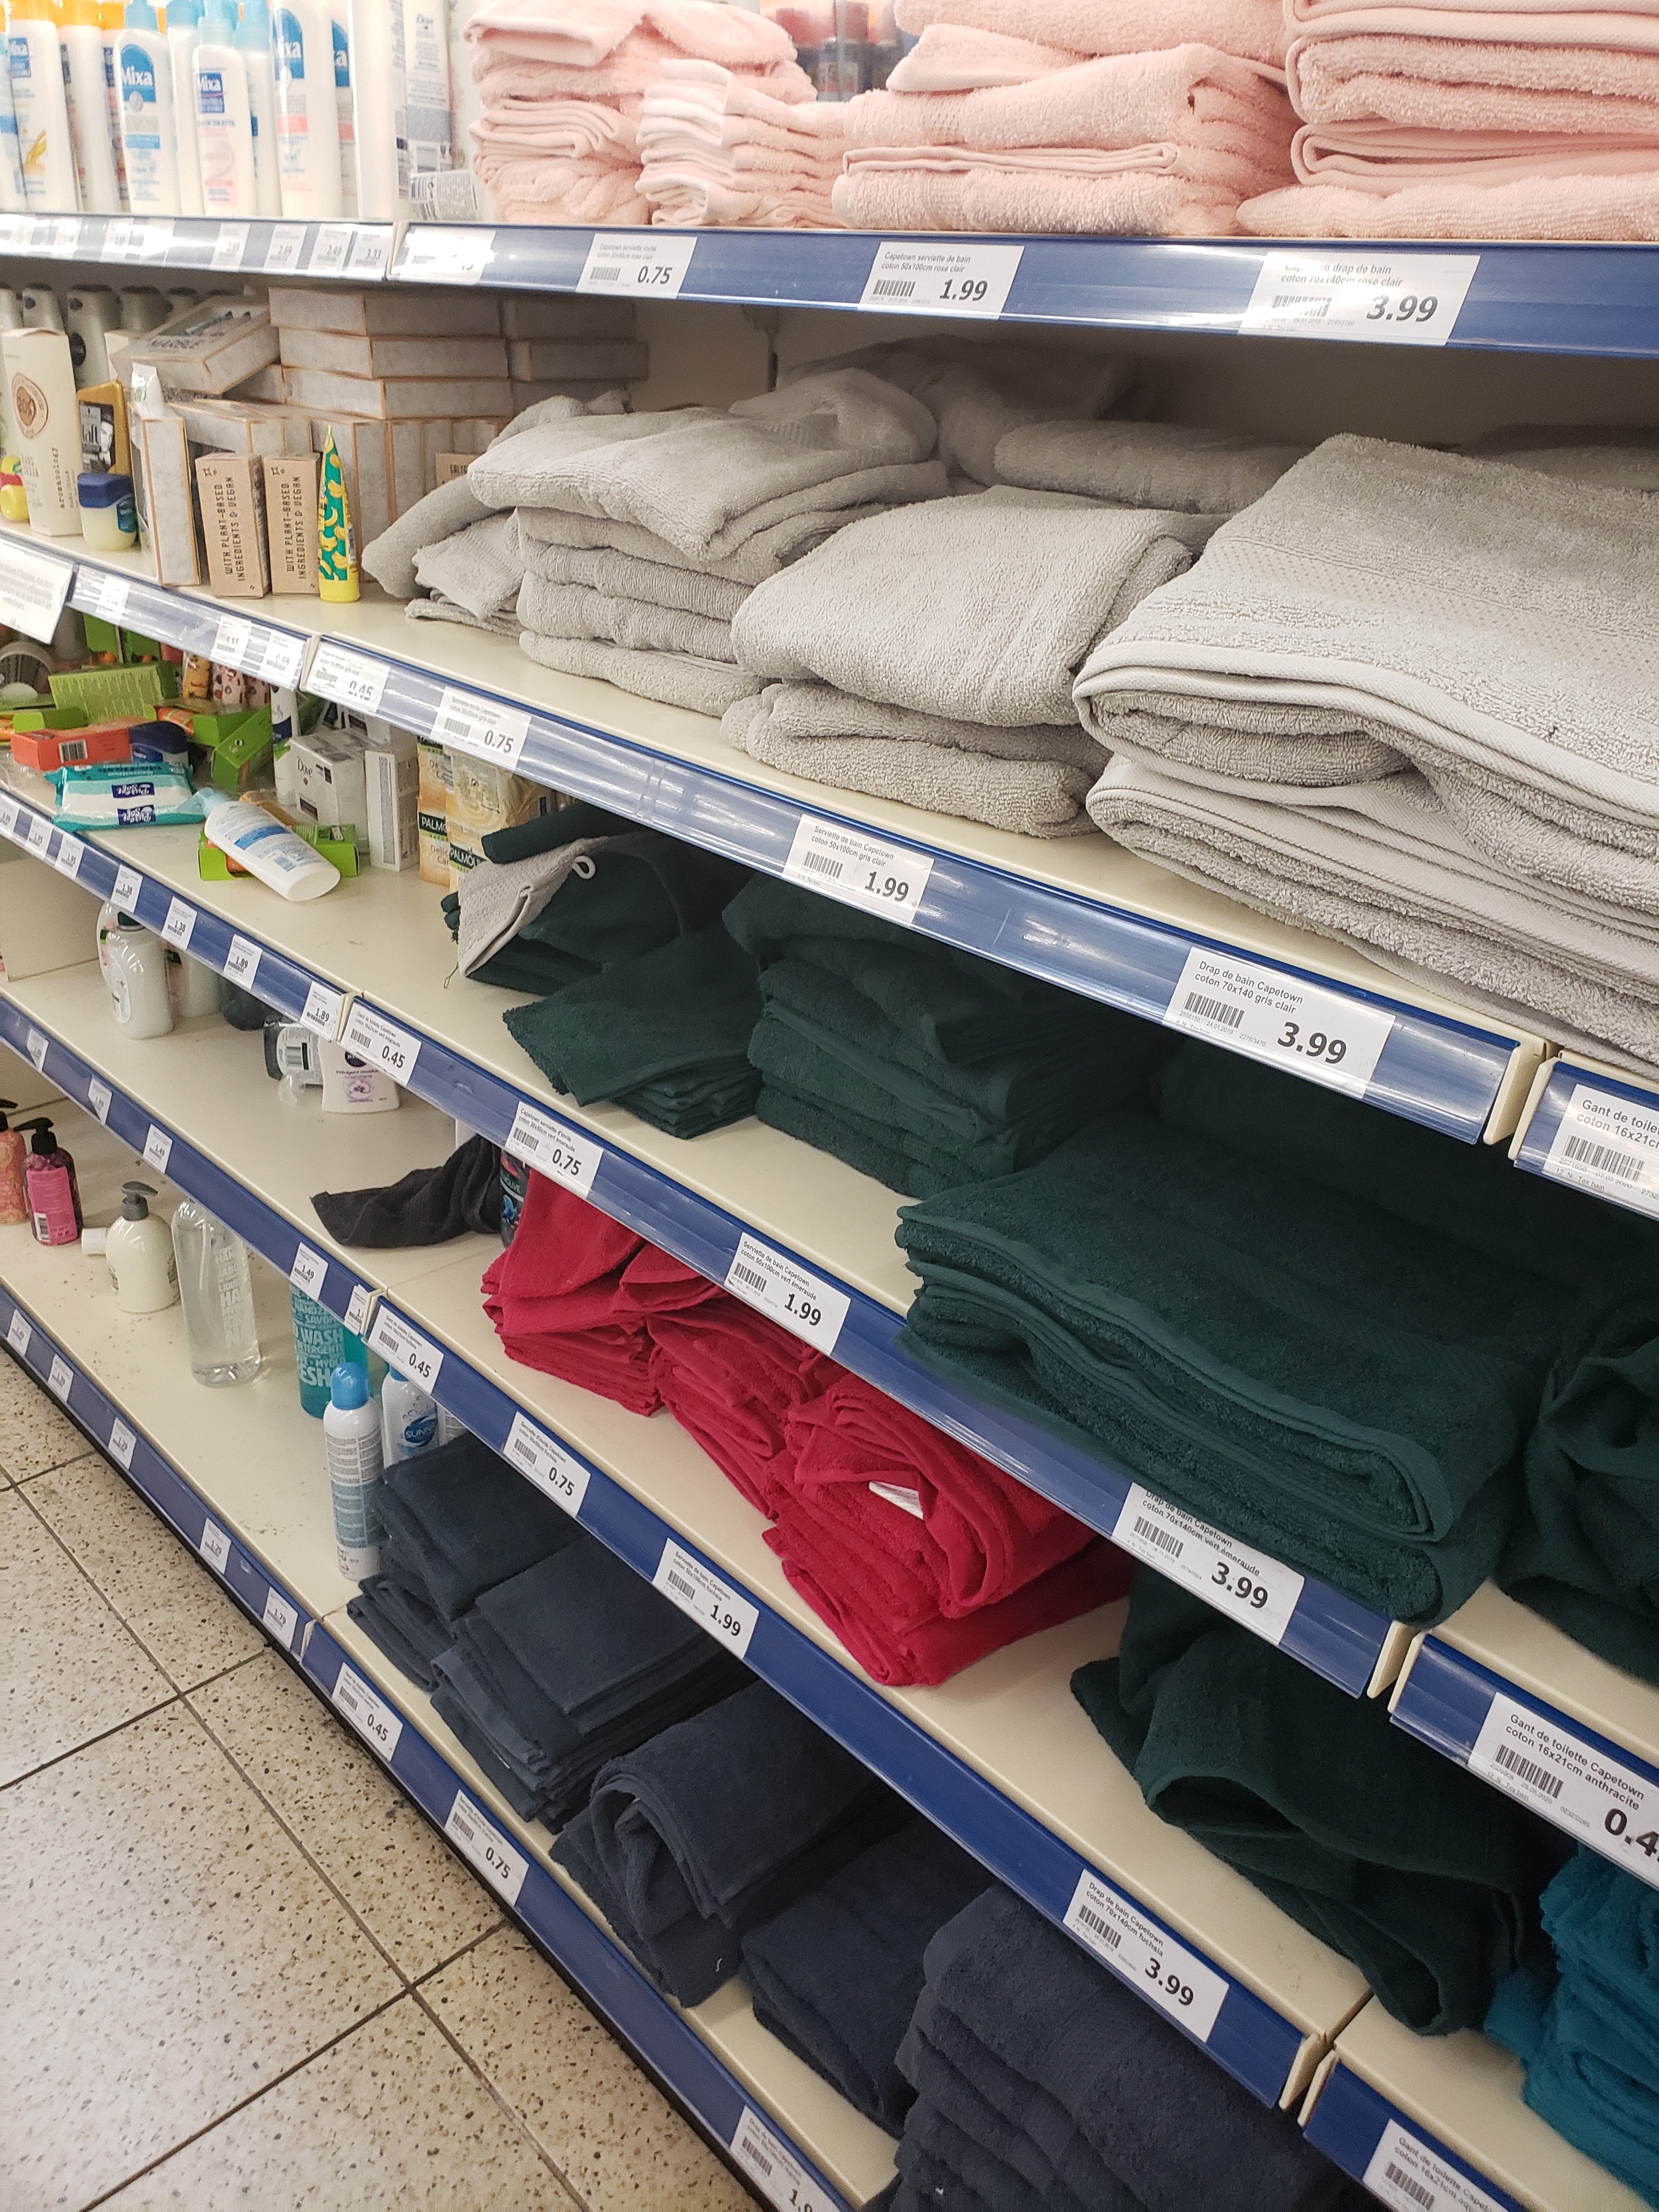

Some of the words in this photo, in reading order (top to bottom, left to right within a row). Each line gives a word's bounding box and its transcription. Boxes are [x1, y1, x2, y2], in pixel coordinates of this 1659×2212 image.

[121, 66, 153, 87] Mixa
[884, 252, 916, 261] Capetown
[917, 253, 945, 262] serviette
[957, 255, 970, 263] bain
[901, 263, 932, 272] 50x100cm
[950, 264, 964, 273] clair
[1333, 264, 1354, 274] drap
[1356, 264, 1369, 274] de
[1371, 266, 1391, 275] bain
[638, 266, 673, 285] 0.75
[1281, 275, 1306, 284] coton
[1381, 277, 1403, 287] clair
[939, 279, 988, 301] 1.99
[1366, 295, 1438, 322] 3.99
[225, 477, 236, 507] VEGAN
[292, 477, 302, 506] VEGAN
[214, 484, 229, 549] PLANT-BASED
[281, 483, 292, 548] PLANT-BASED
[223, 551, 233, 574] WITH
[231, 522, 245, 581] INGREDIENTS
[285, 550, 294, 572] WITH
[295, 521, 306, 579] INGREDIENTS
[348, 680, 374, 701] 0.45
[484, 730, 514, 754] 0.75
[296, 757, 313, 777] Dove
[811, 836, 828, 847] coton
[829, 841, 858, 857] 50x100cm
[859, 851, 871, 862] gris
[872, 855, 886, 867] clair
[814, 825, 840, 840] Serviette
[841, 834, 849, 843] de
[850, 838, 863, 849] bain
[864, 843, 894, 860] Capetown
[122, 884, 133, 894] 1.38
[865, 871, 909, 902] 1.99
[174, 919, 187, 932] 1.38
[235, 956, 249, 969] 1.89
[1195, 973, 1221, 988] coton
[1222, 981, 1254, 1000] 70x140
[1254, 992, 1273, 1007] gris
[1274, 1000, 1296, 1014] clair
[1198, 960, 1220, 976] Drap
[1222, 968, 1233, 980] de
[1235, 973, 1255, 988] bain
[1257, 981, 1304, 1005] Capetown
[315, 1008, 330, 1022] 1.89
[1206, 1020, 1234, 1035] 24.01.2019
[381, 1046, 405, 1068] 0.45
[1277, 1022, 1347, 1064] 3.99
[521, 1108, 540, 1122] Capetown
[540, 1119, 557, 1134] serviette
[1577, 1114, 1610, 1132] coton
[1582, 1099, 1611, 1118] Gant
[1613, 1111, 1628, 1122] de
[518, 1115, 530, 1125] coton
[530, 1122, 548, 1136] 30x50cm
[548, 1132, 556, 1141] vert
[552, 1148, 582, 1176] 0.75
[302, 1265, 314, 1279] 1.49
[741, 1249, 755, 1262] coton
[755, 1257, 780, 1278] 50x100cm
[780, 1273, 791, 1285] vert
[792, 1279, 817, 1301] émeraude
[743, 1240, 765, 1259] Serviette
[765, 1255, 772, 1263] de
[772, 1259, 784, 1271] bain
[785, 1267, 810, 1287] Capetown
[784, 1293, 821, 1326] 1.99
[301, 1328, 343, 1345] WASH
[409, 1353, 431, 1378] 0.45
[549, 1466, 575, 1497] 0.75
[1142, 1499, 1164, 1517] coton
[1165, 1511, 1203, 1542] 70x140cm
[1204, 1535, 1220, 1551] vert
[1220, 1543, 1260, 1576] émeraude
[1165, 1502, 1175, 1513] de
[1176, 1506, 1193, 1523] bain
[1194, 1519, 1233, 1548] Capetown
[709, 1579, 731, 1601] Capetown
[1211, 1561, 1268, 1609] 3.99
[710, 1604, 741, 1637] 1.99
[367, 1713, 389, 1741] 0.45
[1506, 1725, 1535, 1747] coton
[1537, 1743, 1583, 1777] 16x21cm
[1584, 1772, 1640, 1811] anthracite
[1510, 1714, 1536, 1734] Gant
[1537, 1729, 1550, 1742] de
[1551, 1738, 1588, 1766] toilette
[1590, 1762, 1645, 1801] Capetown
[1604, 1808, 1659, 1863] 0.4
[486, 1847, 511, 1879] 0.75
[1086, 1890, 1105, 1908] coton
[1105, 1904, 1138, 1936] 70x140cm
[1138, 1931, 1164, 1957] fuchsia
[1088, 1881, 1105, 1899] Drap
[1105, 1895, 1114, 1906] de
[1115, 1902, 1130, 1921] bain
[1130, 1915, 1165, 1946] Capetown
[1144, 1956, 1194, 2006] 3.99
[1394, 2146, 1419, 2168] coton
[1398, 2137, 1419, 2157] Gant
[1420, 2153, 1431, 2166] de
